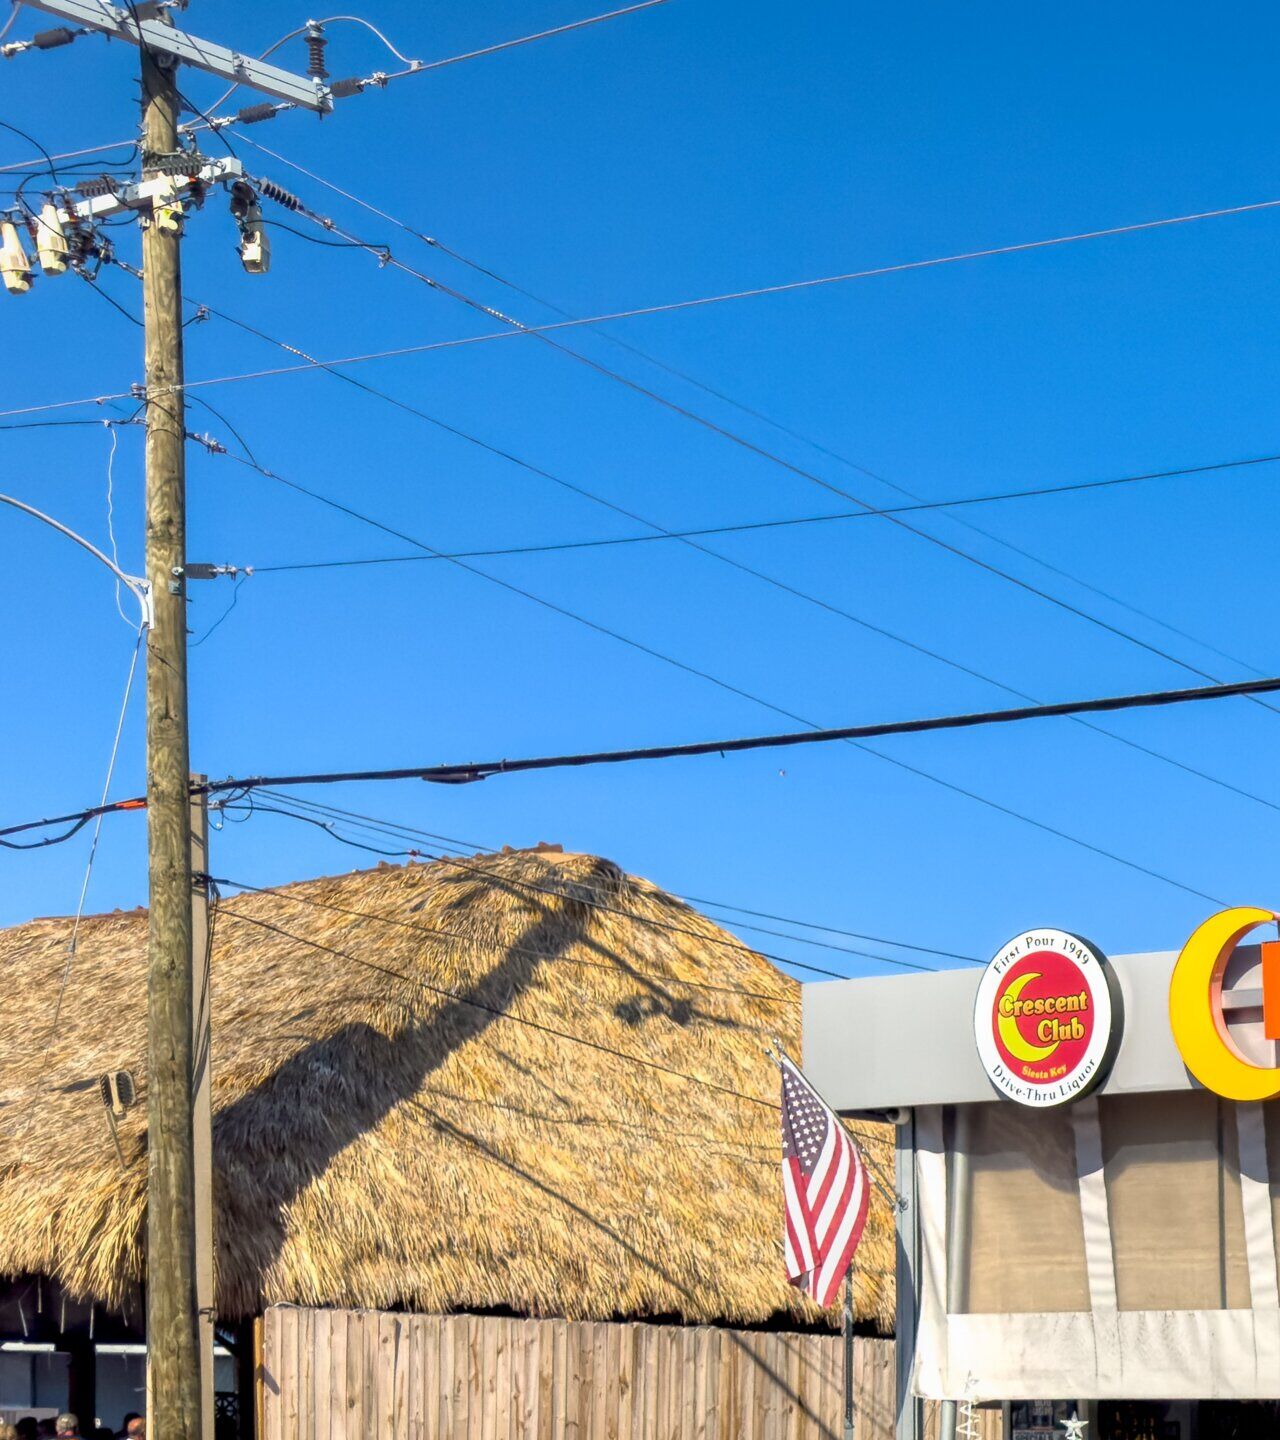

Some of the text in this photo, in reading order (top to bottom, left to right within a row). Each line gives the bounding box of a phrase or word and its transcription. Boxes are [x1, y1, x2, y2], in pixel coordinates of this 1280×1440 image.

[993, 936, 1090, 974] First Pour 1949
[998, 990, 1088, 1018] Crescent
[1037, 1016, 1085, 1042] Club
[993, 1058, 1095, 1101] Drive-Thru Liquor
[1021, 1064, 1067, 1079] Siesta Key
